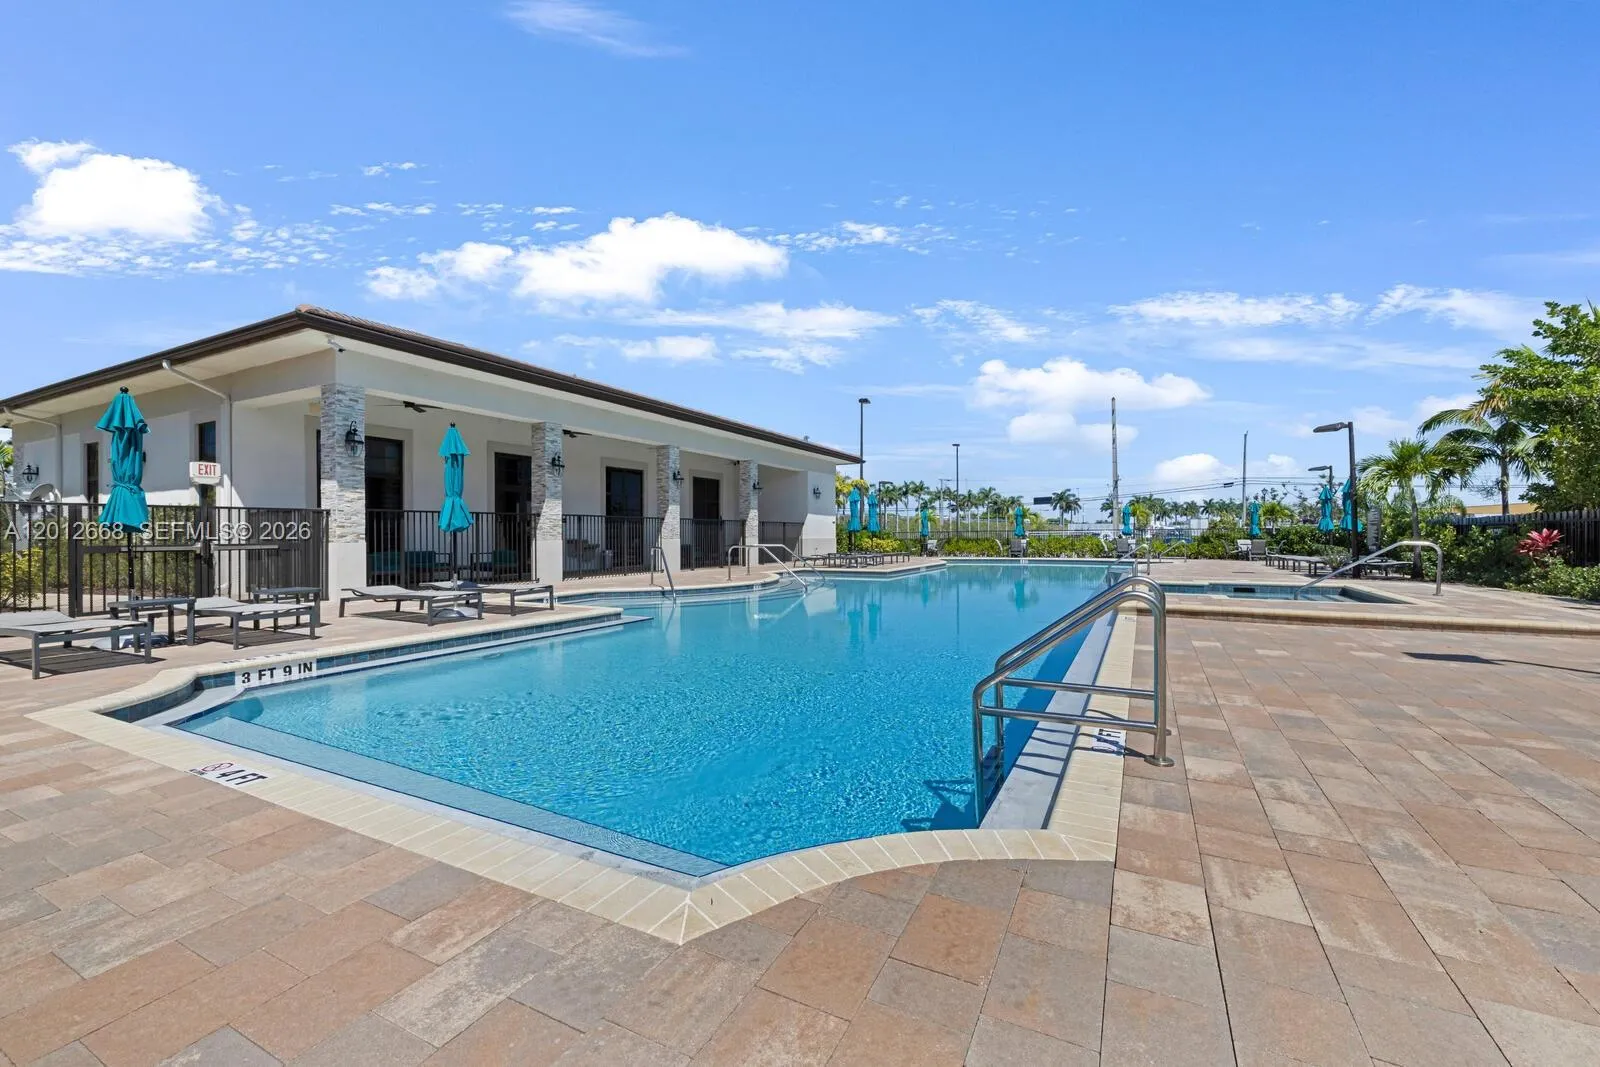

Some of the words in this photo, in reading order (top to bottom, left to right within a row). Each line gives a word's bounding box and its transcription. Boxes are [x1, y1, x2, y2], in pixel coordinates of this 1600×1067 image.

[198, 463, 217, 476] EXIT
[241, 671, 251, 684] 3
[257, 667, 276, 680] FT
[283, 665, 292, 676] 9
[298, 661, 313, 674] IN
[216, 769, 245, 779] 4
[225, 773, 268, 785] FT
